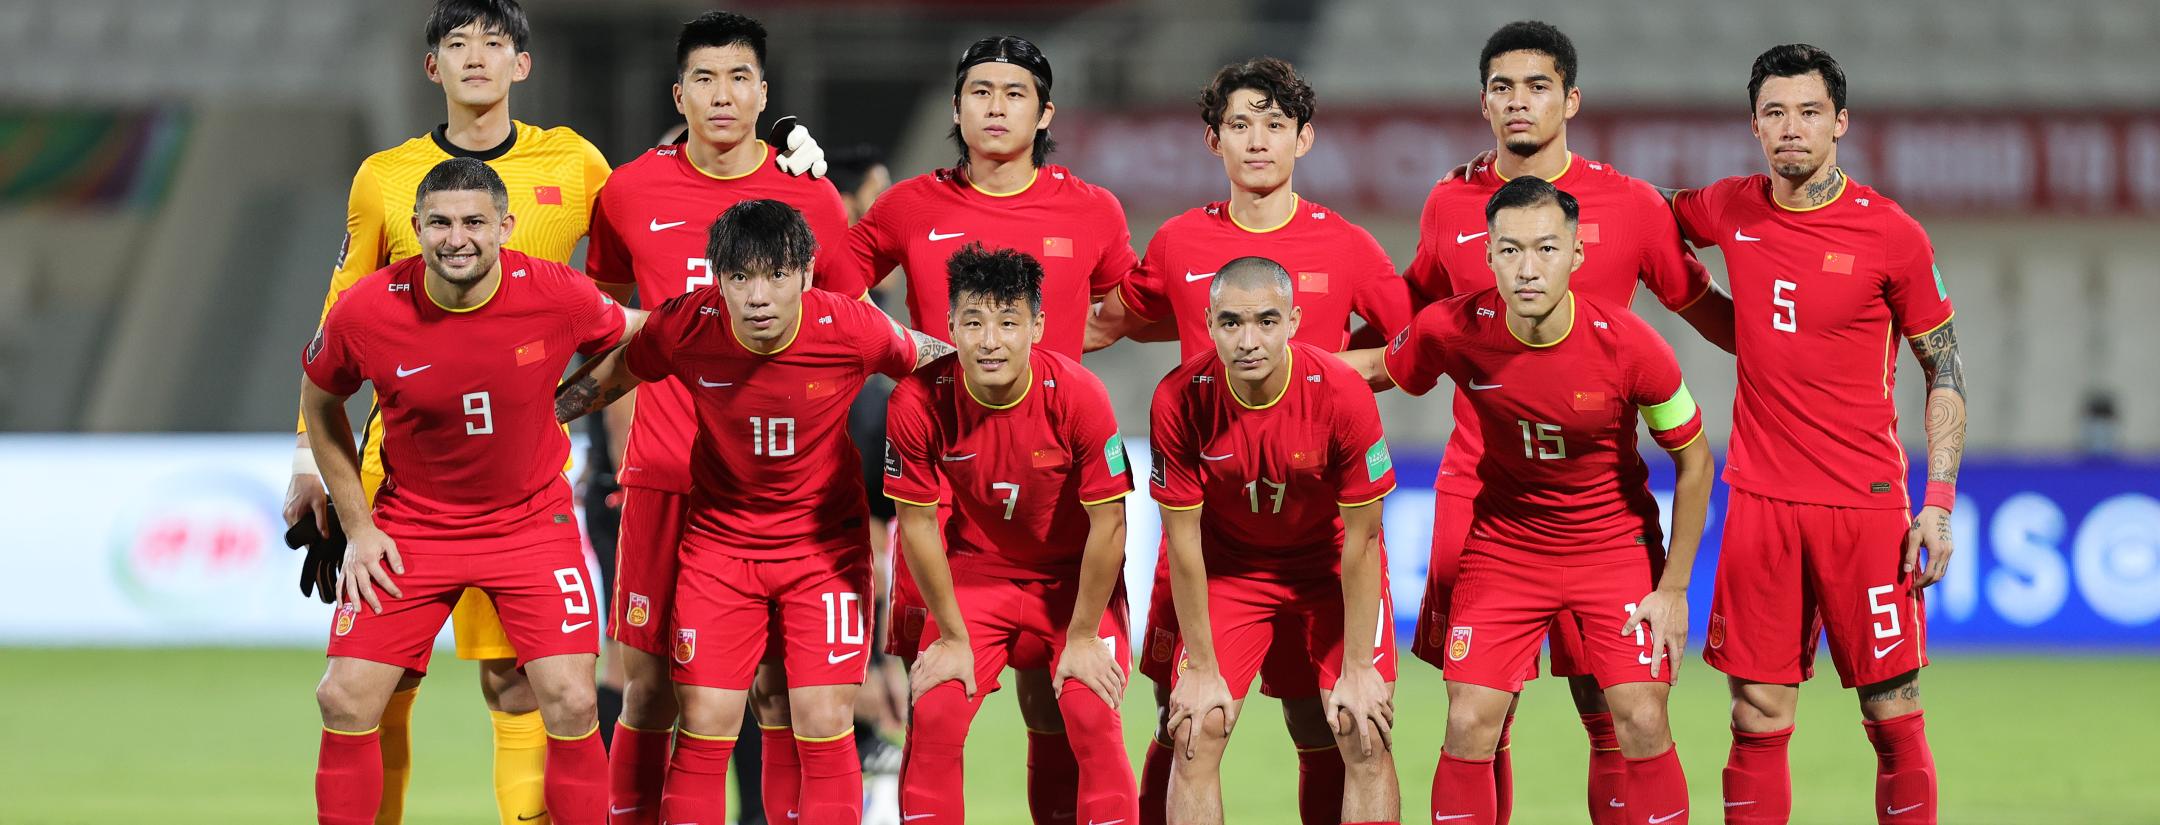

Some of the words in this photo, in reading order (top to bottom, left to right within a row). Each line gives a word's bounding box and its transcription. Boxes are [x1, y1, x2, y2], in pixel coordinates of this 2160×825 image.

[388, 283, 410, 292] CFA
[1772, 279, 1797, 333] 5
[700, 306, 720, 317] CFA
[1476, 307, 1496, 319] CFA
[1306, 374, 1321, 383] 中国
[463, 391, 494, 435] 9
[750, 416, 795, 457] 10
[1518, 420, 1567, 460] 15
[992, 482, 1020, 520] 7
[1245, 477, 1287, 514] 17
[553, 567, 591, 615] 9
[821, 592, 864, 645] 10
[1867, 584, 1901, 639] 5
